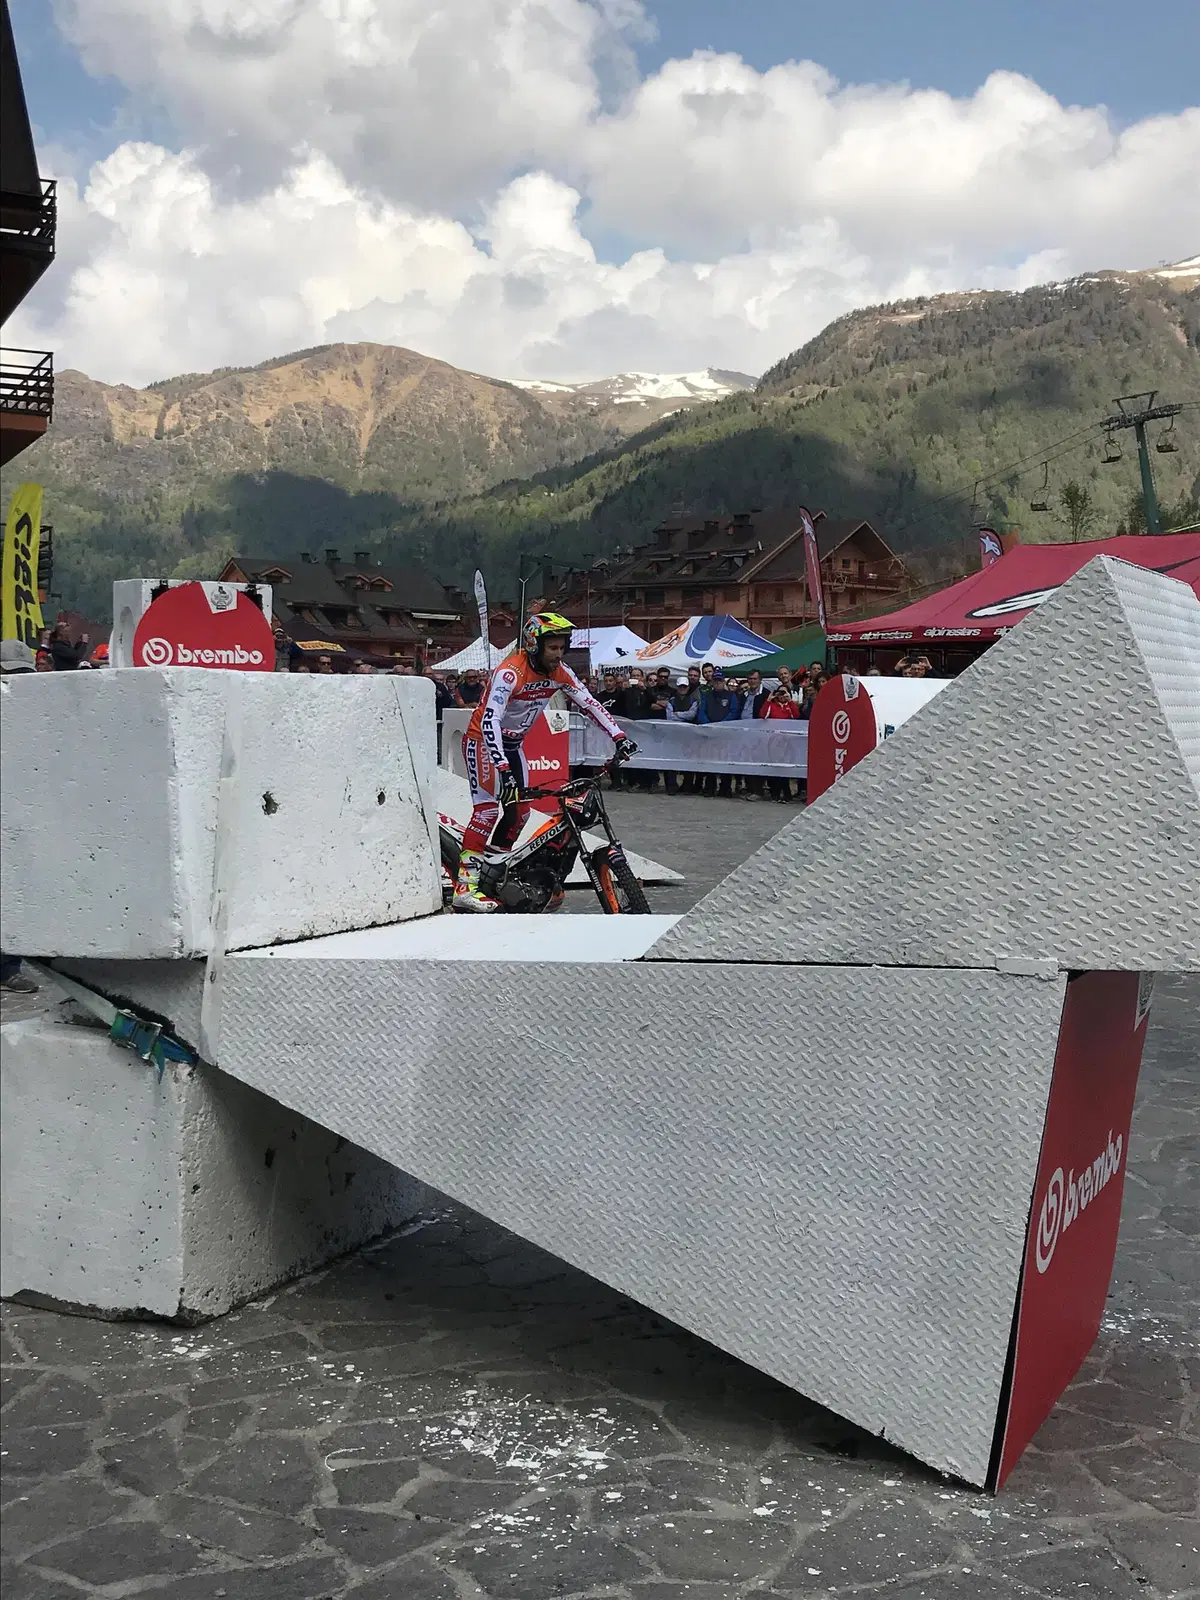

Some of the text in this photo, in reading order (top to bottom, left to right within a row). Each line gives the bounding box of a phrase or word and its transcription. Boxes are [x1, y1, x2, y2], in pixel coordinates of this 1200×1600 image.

[859, 630, 914, 642] alpinestars
[923, 627, 982, 638] alpinestars
[994, 626, 1013, 636] alp
[177, 643, 264, 665] brembo
[467, 739, 479, 795] REPSOL
[528, 756, 561, 770] mbo
[835, 748, 848, 784] br
[529, 826, 561, 851] REPSOL
[1063, 1128, 1123, 1233] brembo
